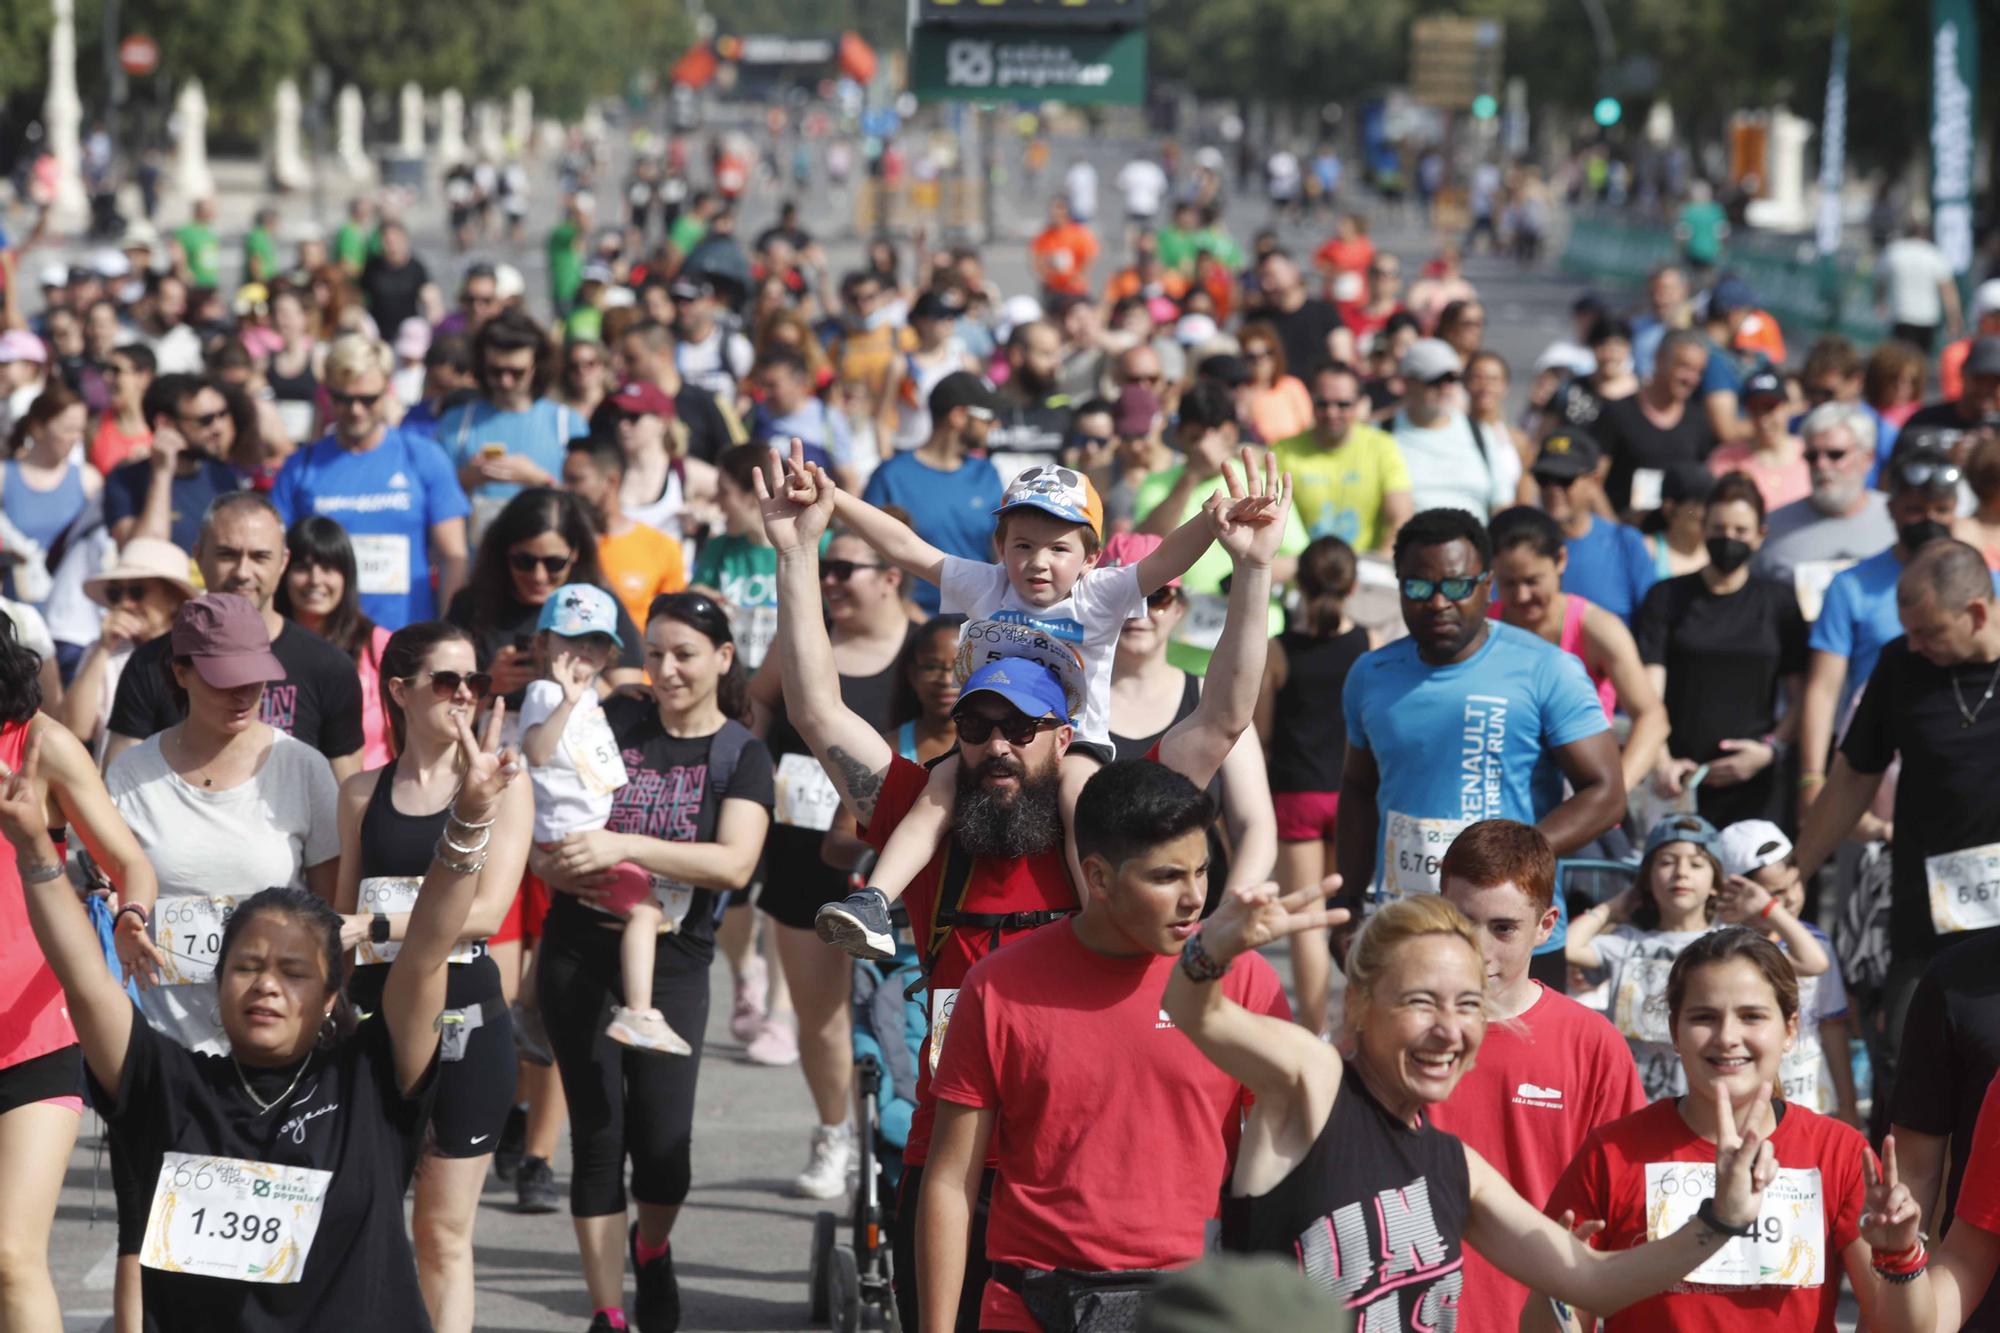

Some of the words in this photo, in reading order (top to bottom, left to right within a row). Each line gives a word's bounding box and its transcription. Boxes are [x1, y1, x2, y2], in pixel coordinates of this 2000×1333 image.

[1487, 706, 1508, 752] RUN
[1461, 704, 1486, 822] RENAULT
[1484, 755, 1505, 821] TREET
[173, 1160, 214, 1190] 66
[191, 1207, 281, 1244] 1.398
